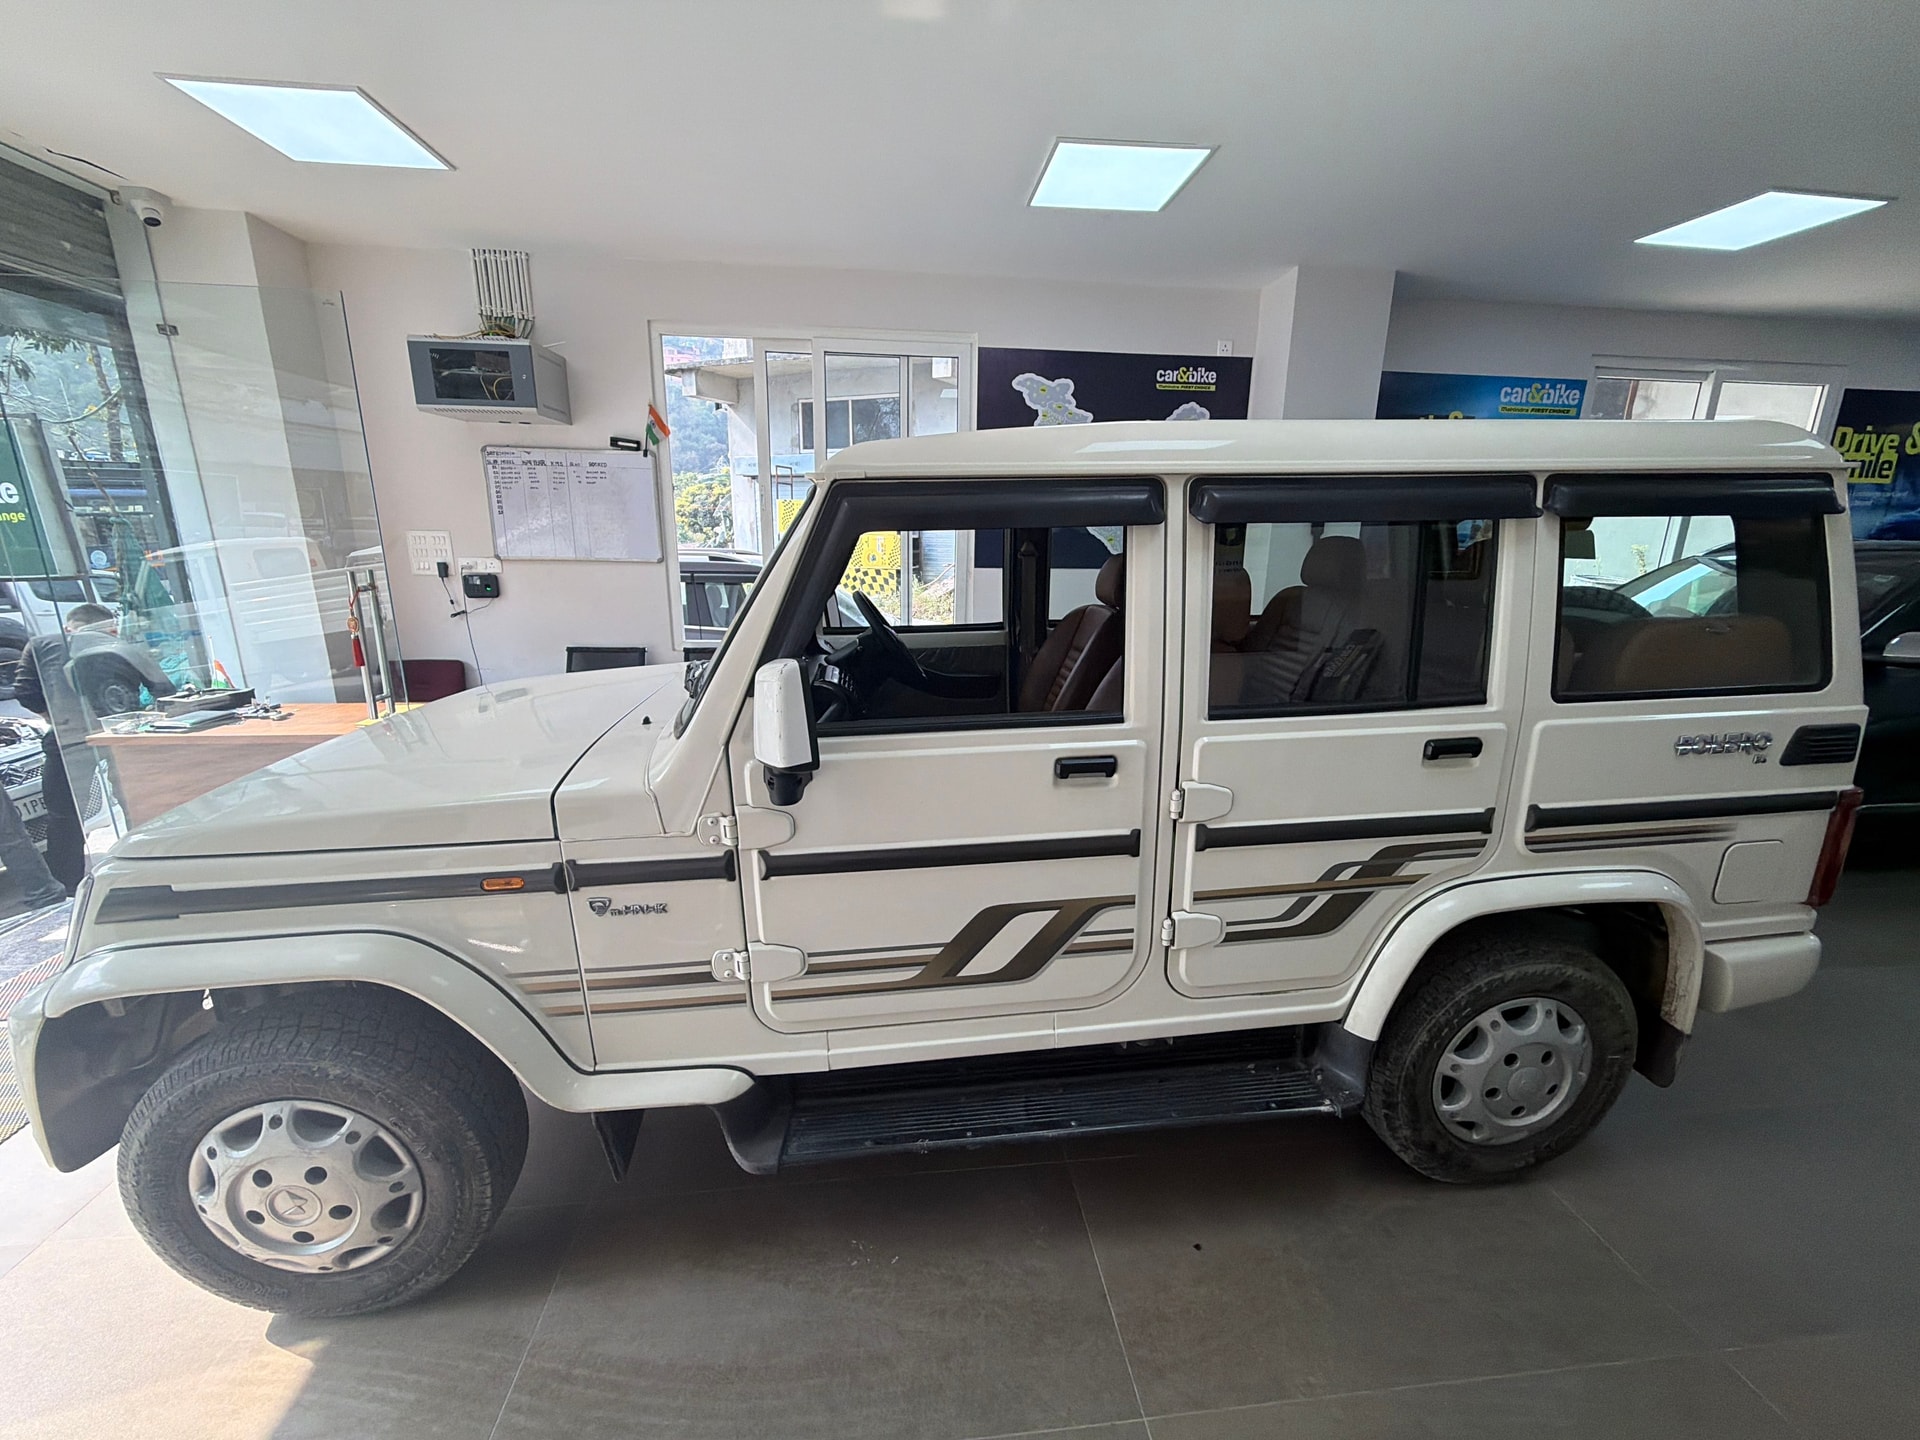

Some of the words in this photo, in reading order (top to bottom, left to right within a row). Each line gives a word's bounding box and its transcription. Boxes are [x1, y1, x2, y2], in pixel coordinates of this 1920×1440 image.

[1156, 366, 1217, 383] car&bike
[1500, 383, 1580, 405] car&bike
[1833, 425, 1900, 454] Drive
[1675, 731, 1773, 756] BOLERO
